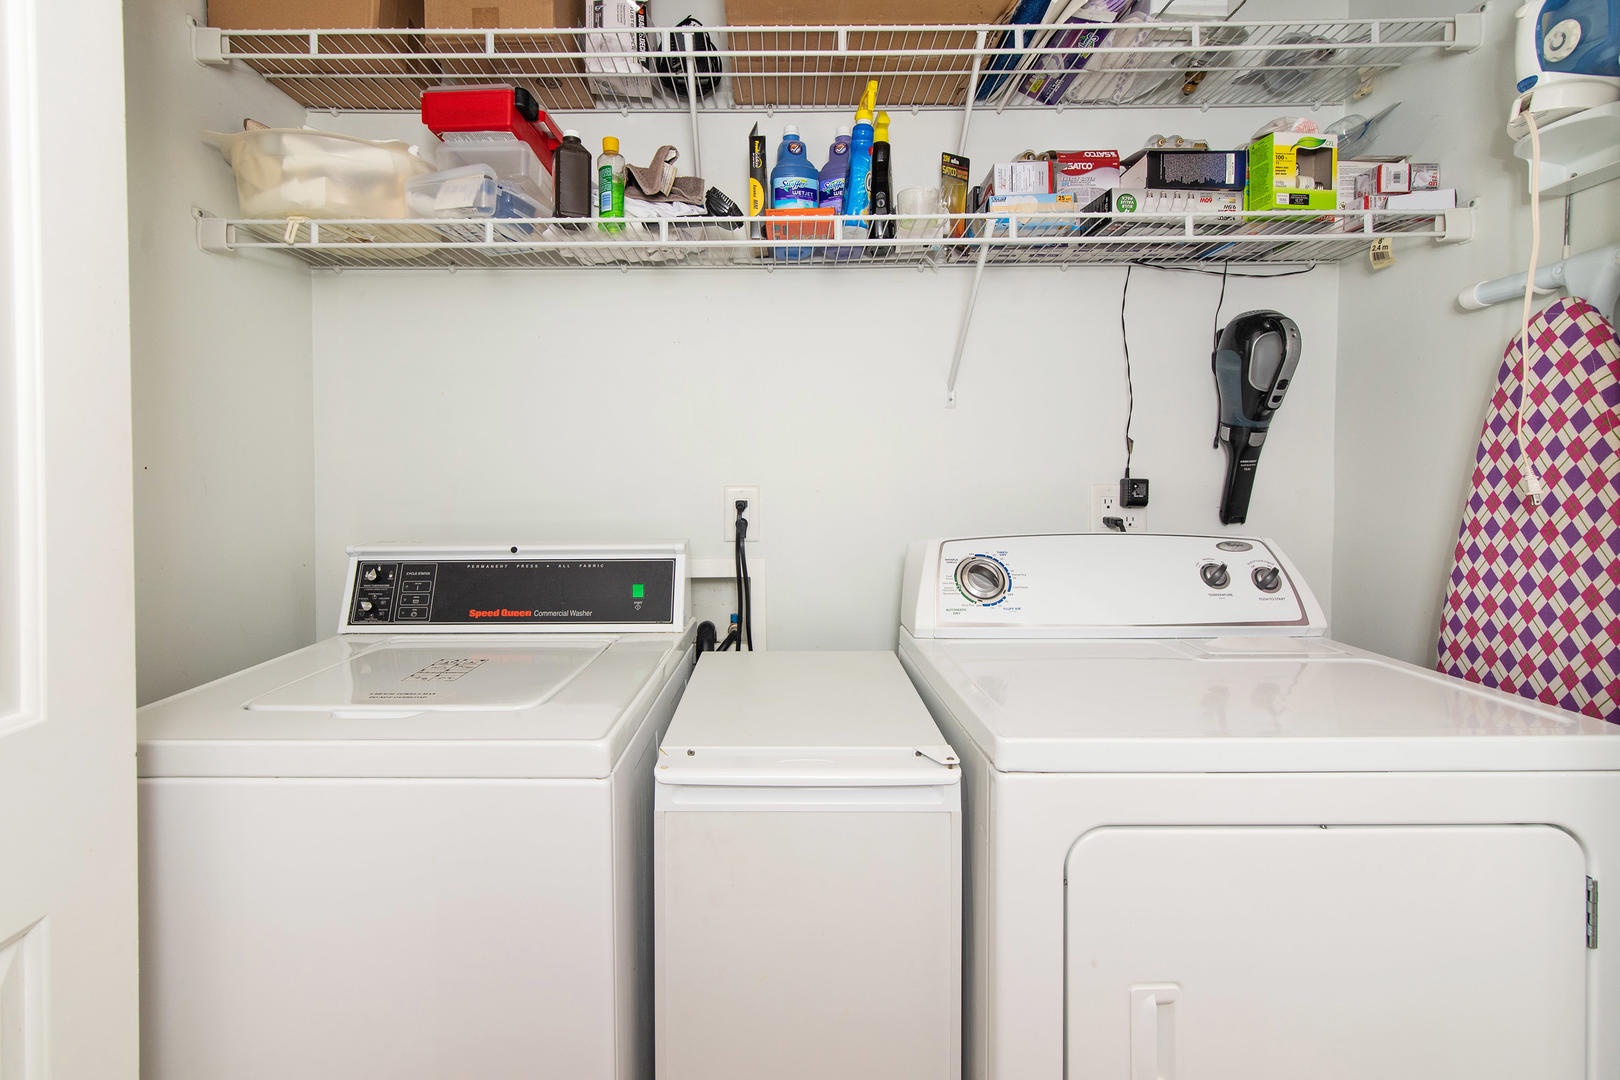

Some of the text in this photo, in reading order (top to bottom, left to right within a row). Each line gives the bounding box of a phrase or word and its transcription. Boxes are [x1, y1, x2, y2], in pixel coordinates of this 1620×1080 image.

[1066, 162, 1093, 170] SATCO
[469, 609, 593, 618] Speed Queen Commercial Washer
